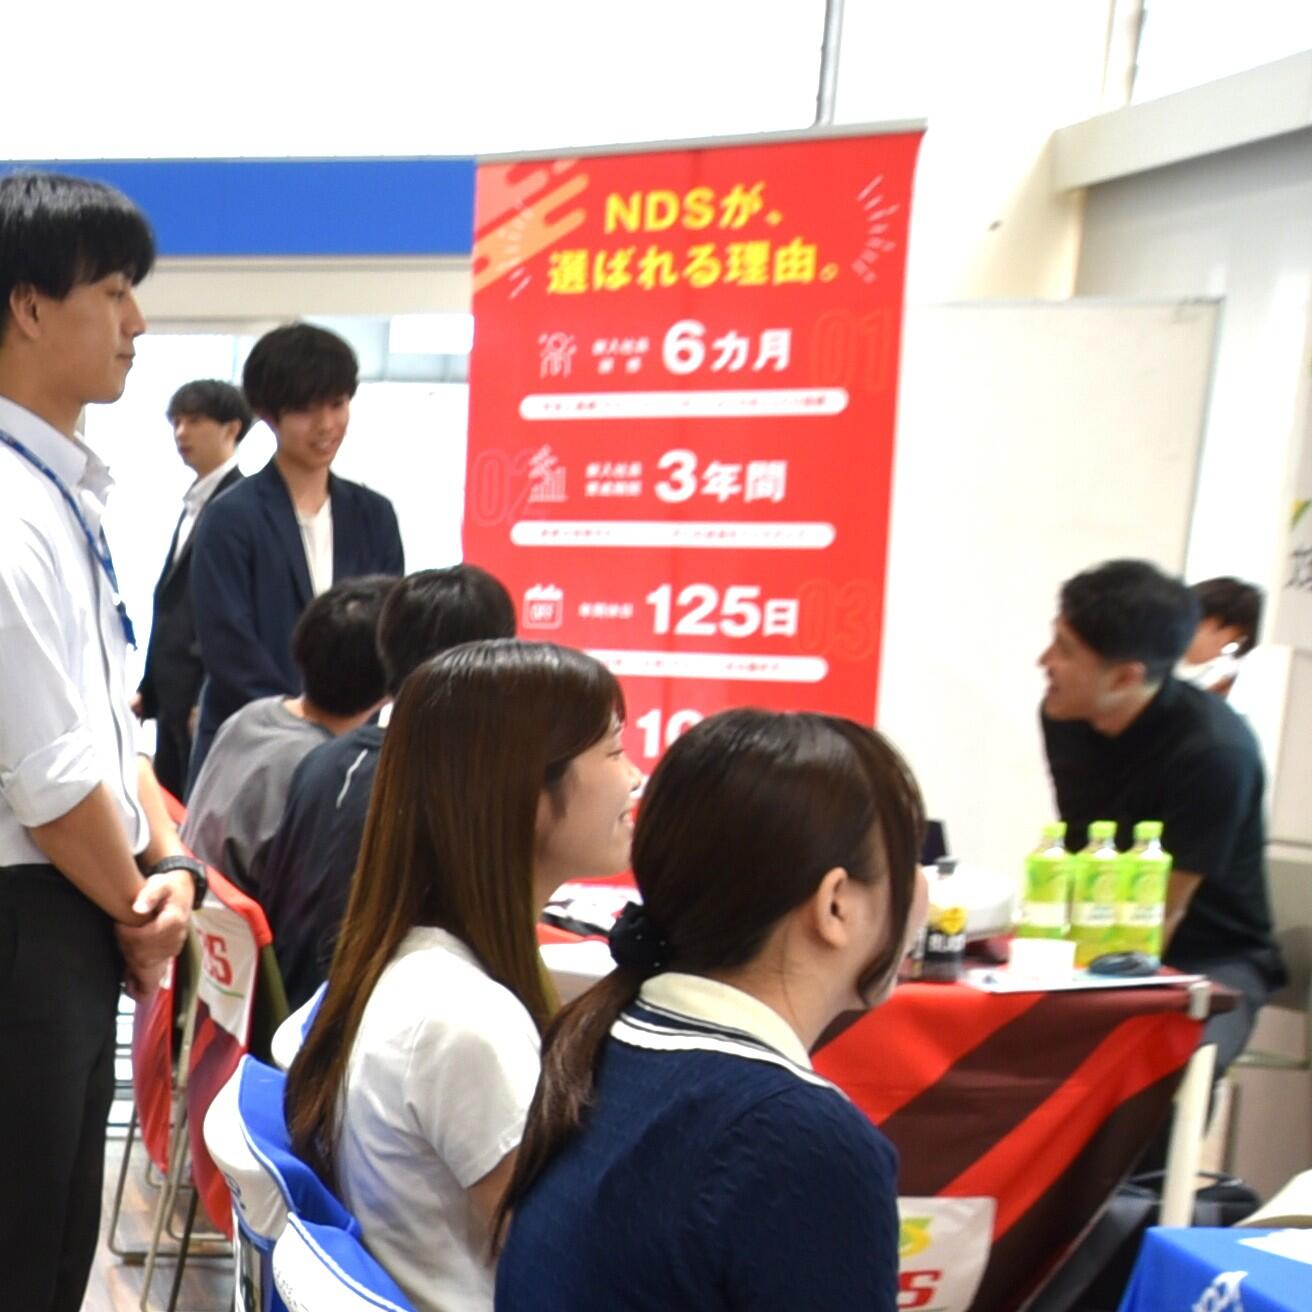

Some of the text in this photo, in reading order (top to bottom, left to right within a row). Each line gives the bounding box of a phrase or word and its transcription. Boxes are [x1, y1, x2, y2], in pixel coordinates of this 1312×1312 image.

[547, 237, 839, 294] 選ばれる理由。
[655, 449, 789, 503] 3年間
[646, 583, 799, 638] 125日
